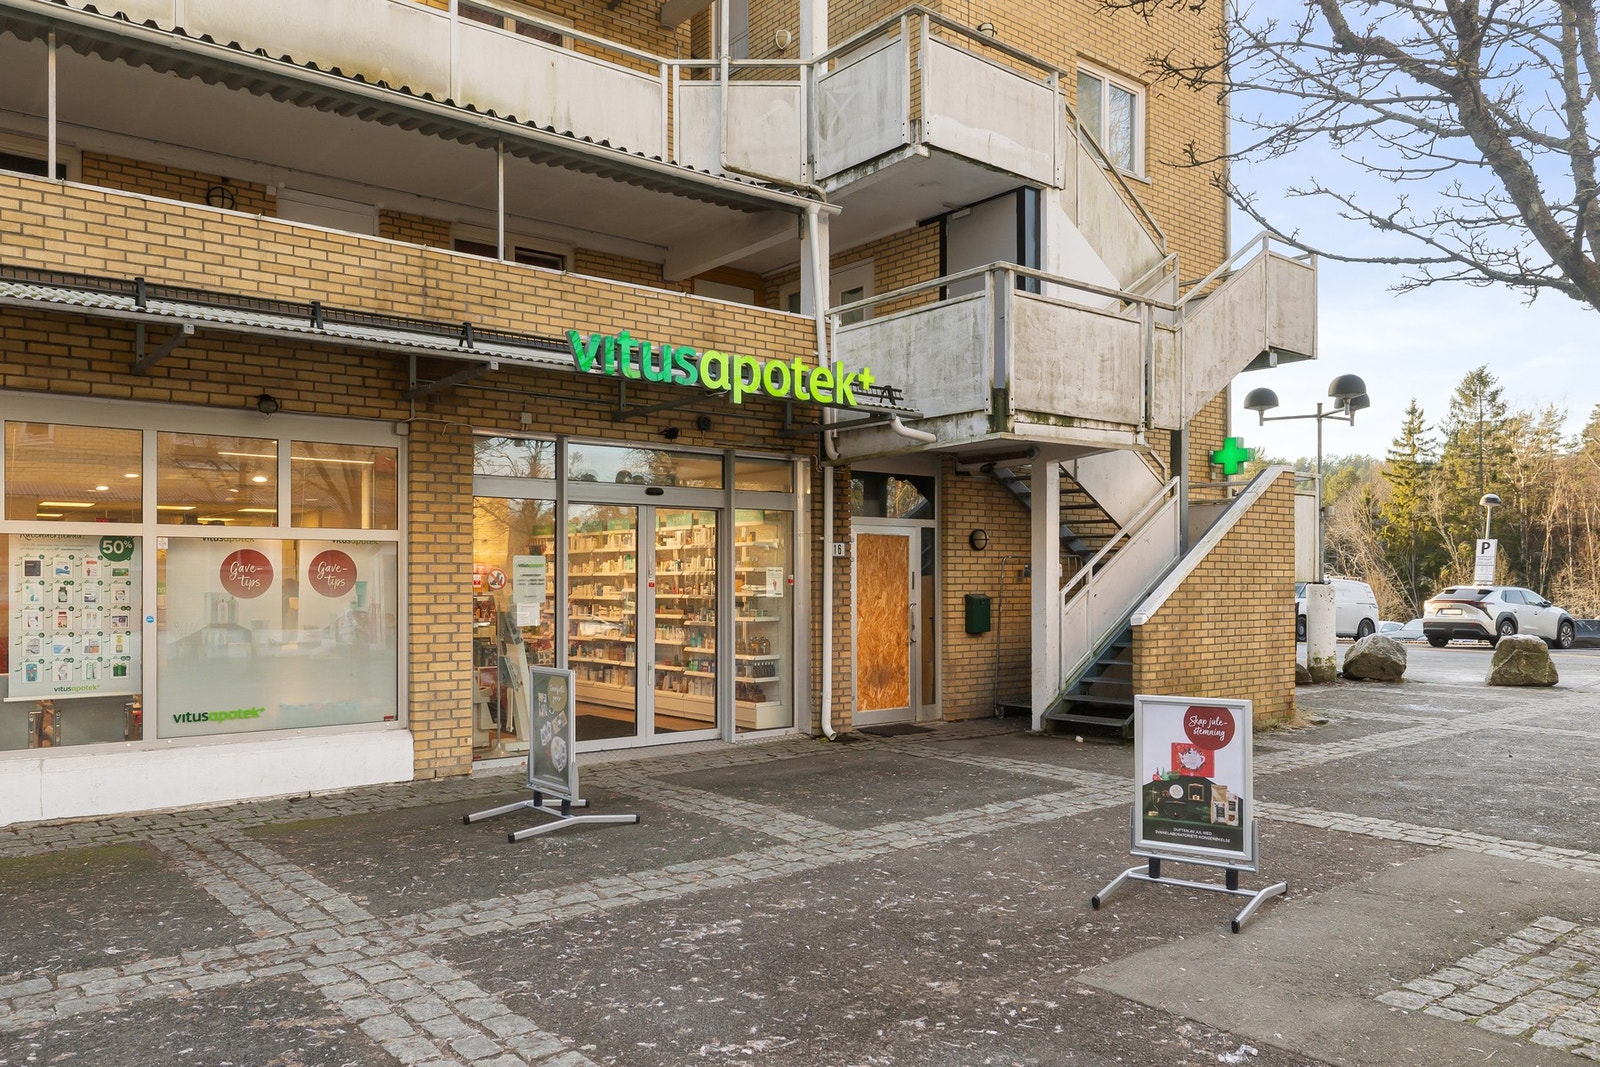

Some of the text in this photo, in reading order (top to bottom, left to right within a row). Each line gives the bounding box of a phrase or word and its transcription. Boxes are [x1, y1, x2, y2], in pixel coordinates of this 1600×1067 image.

[102, 540, 133, 554] 50%
[833, 544, 842, 555] 16
[1481, 542, 1491, 554] P
[229, 561, 263, 580] Gave-
[316, 561, 348, 580] Gave-
[238, 574, 261, 590] tips
[324, 574, 346, 590] tips
[1188, 715, 1228, 729] Skap jule-
[1193, 727, 1226, 742] stemning
